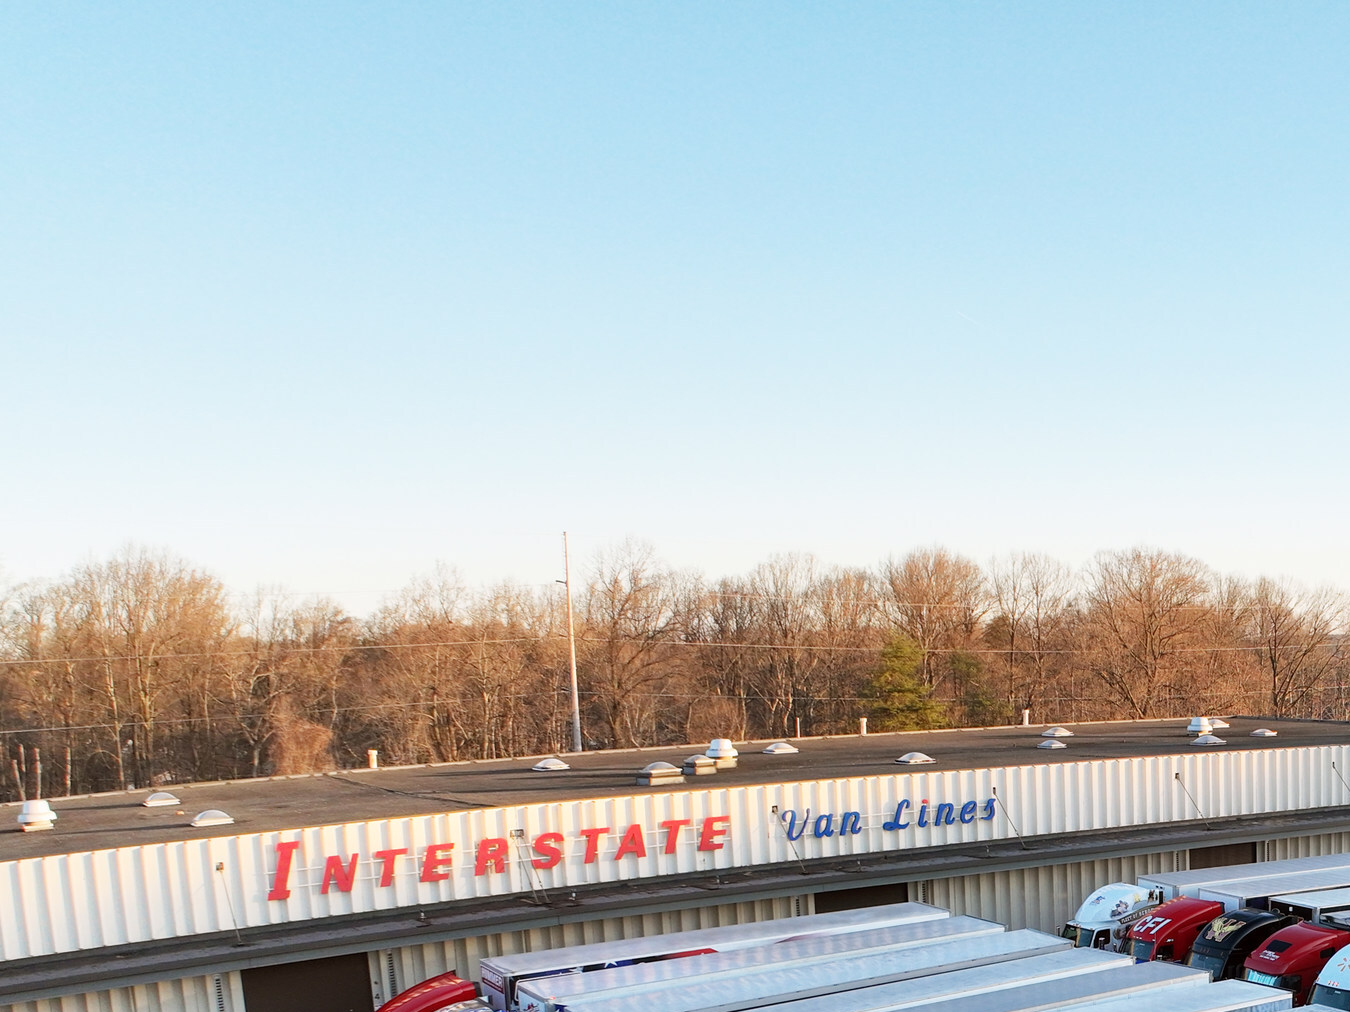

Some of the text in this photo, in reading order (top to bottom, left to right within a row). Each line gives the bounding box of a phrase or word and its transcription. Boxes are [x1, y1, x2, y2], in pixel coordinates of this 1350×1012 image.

[267, 798, 996, 901] INTERSTATE Van Lines
[1133, 915, 1172, 934] CFI
